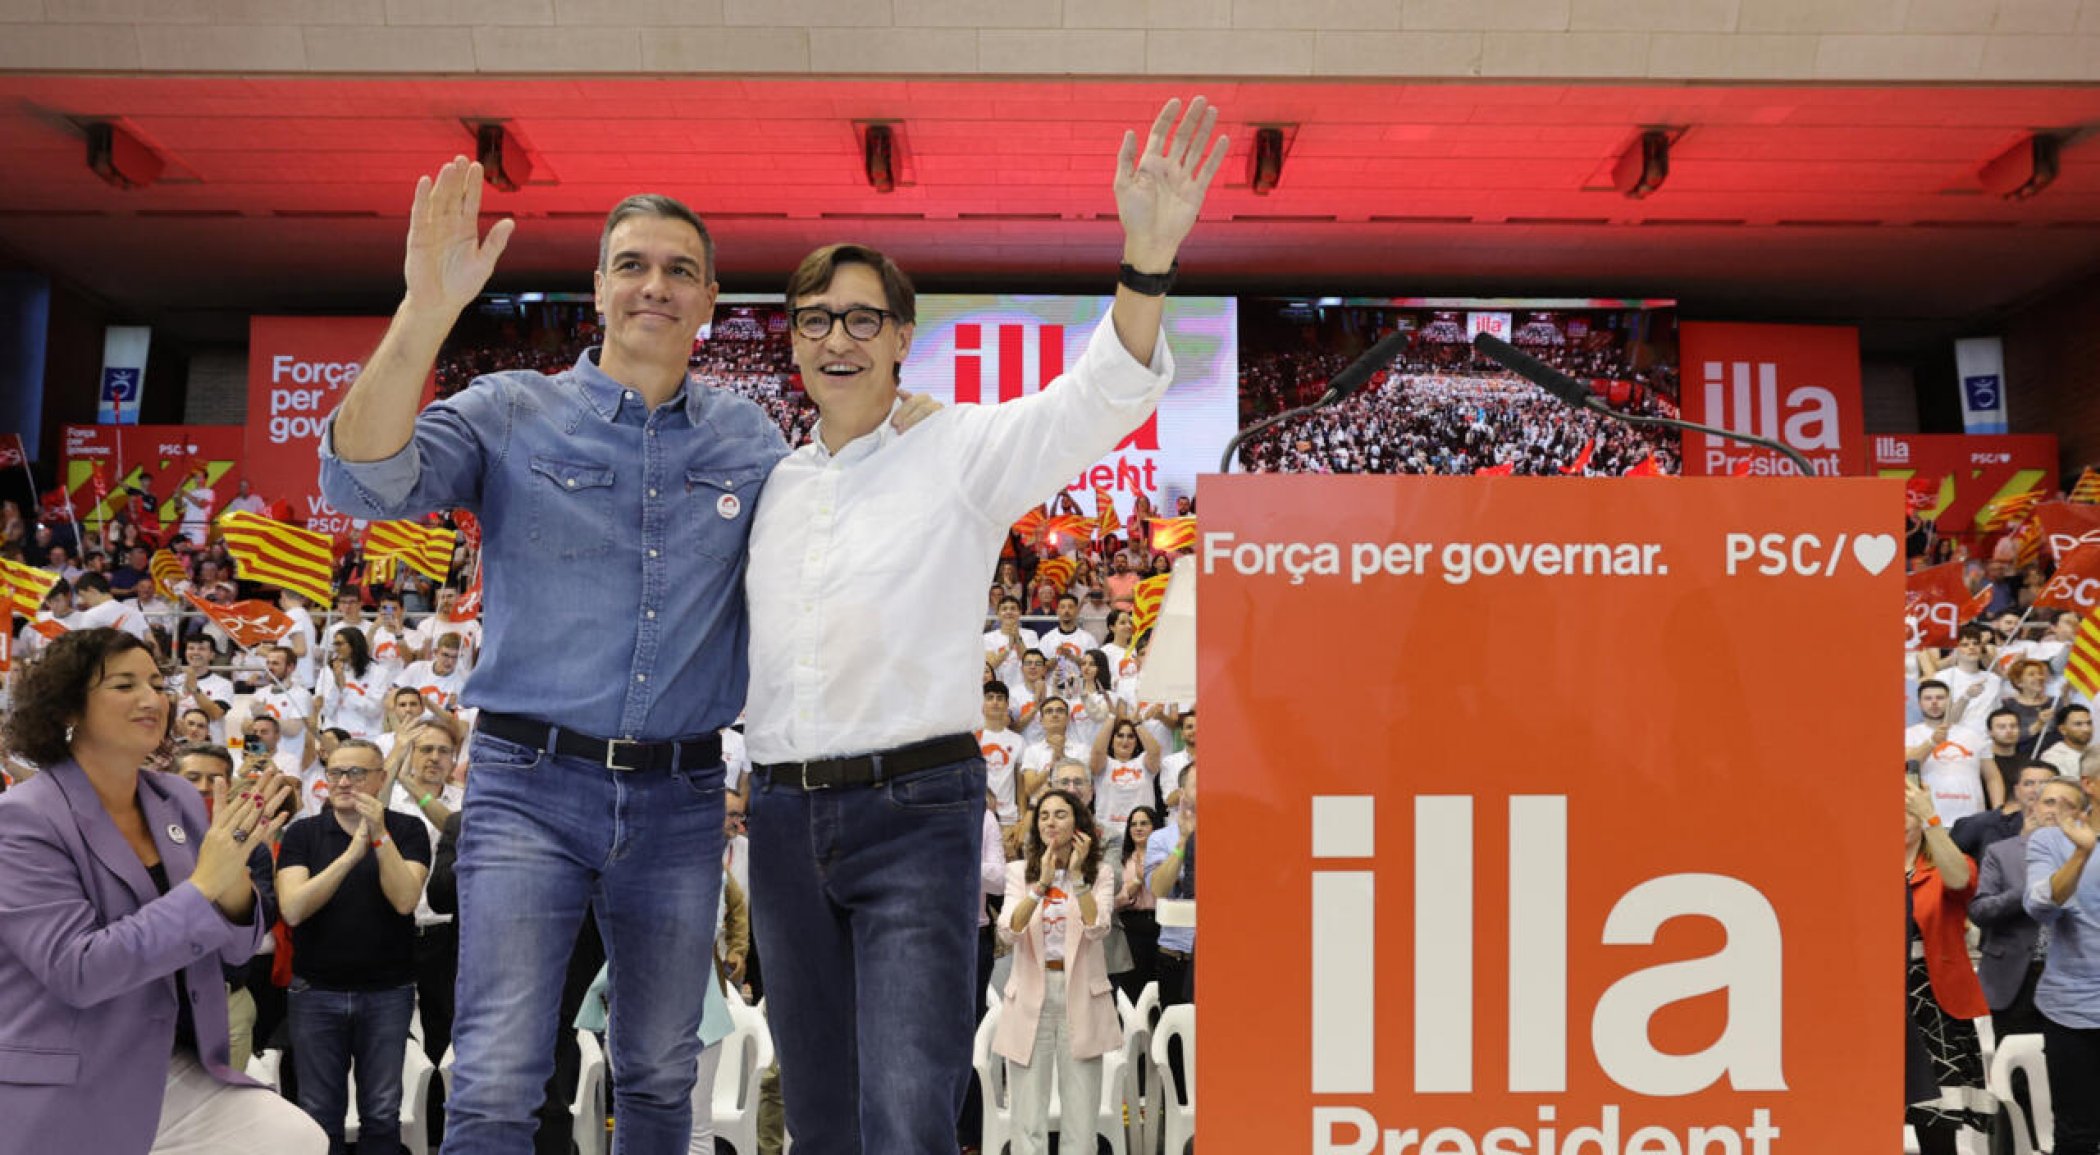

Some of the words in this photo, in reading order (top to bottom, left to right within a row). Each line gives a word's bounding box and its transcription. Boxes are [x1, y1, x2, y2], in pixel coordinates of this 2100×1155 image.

[271, 388, 324, 415] per
[1703, 360, 1842, 450] illa
[159, 443, 185, 455] PSC
[1876, 437, 1909, 457] illa
[1706, 450, 1841, 476] Prsidnt
[1203, 532, 1340, 585] Força
[1351, 543, 1433, 584] per
[1441, 542, 1668, 585] governar.
[1311, 794, 1790, 1097] illa
